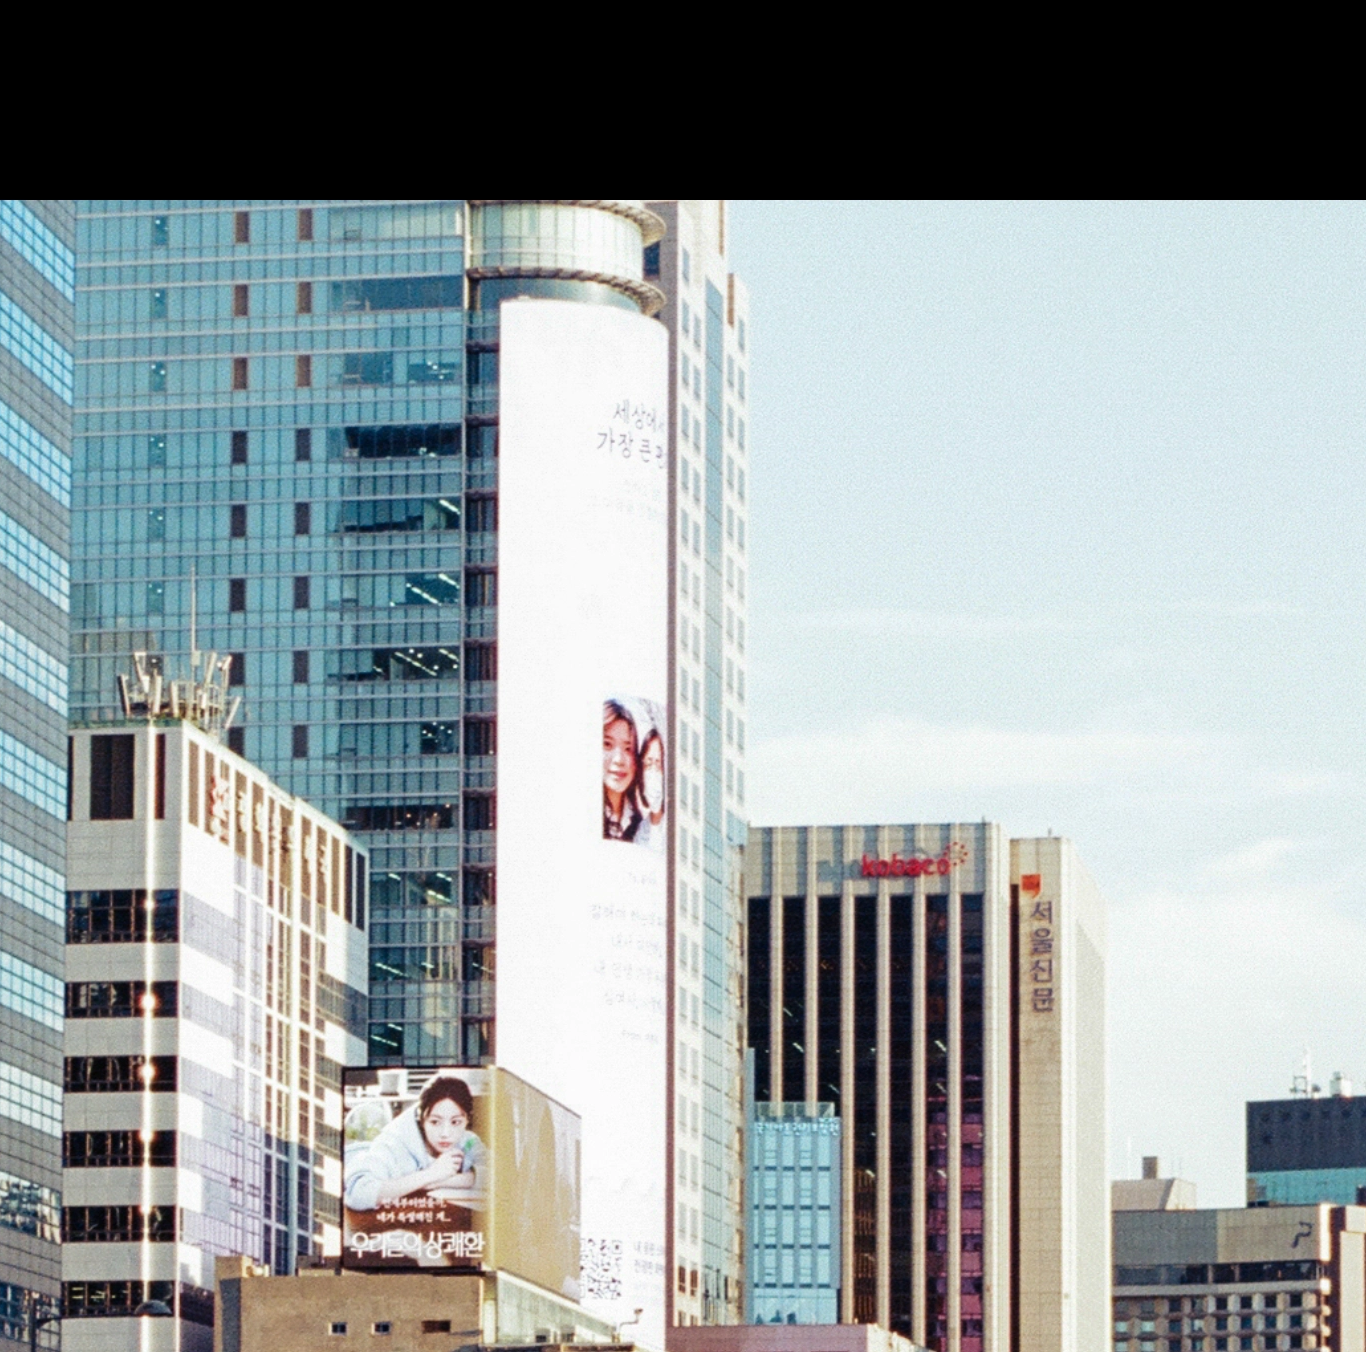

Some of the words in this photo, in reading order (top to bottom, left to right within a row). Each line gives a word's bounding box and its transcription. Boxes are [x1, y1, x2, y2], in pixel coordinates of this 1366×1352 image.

[596, 428, 634, 459] 가장
[638, 438, 652, 463] 큰
[861, 853, 952, 879] kobaco
[1028, 899, 1055, 1014] 서울신문
[350, 1232, 422, 1259] 우리들의
[424, 1231, 485, 1259] 상쾌환
